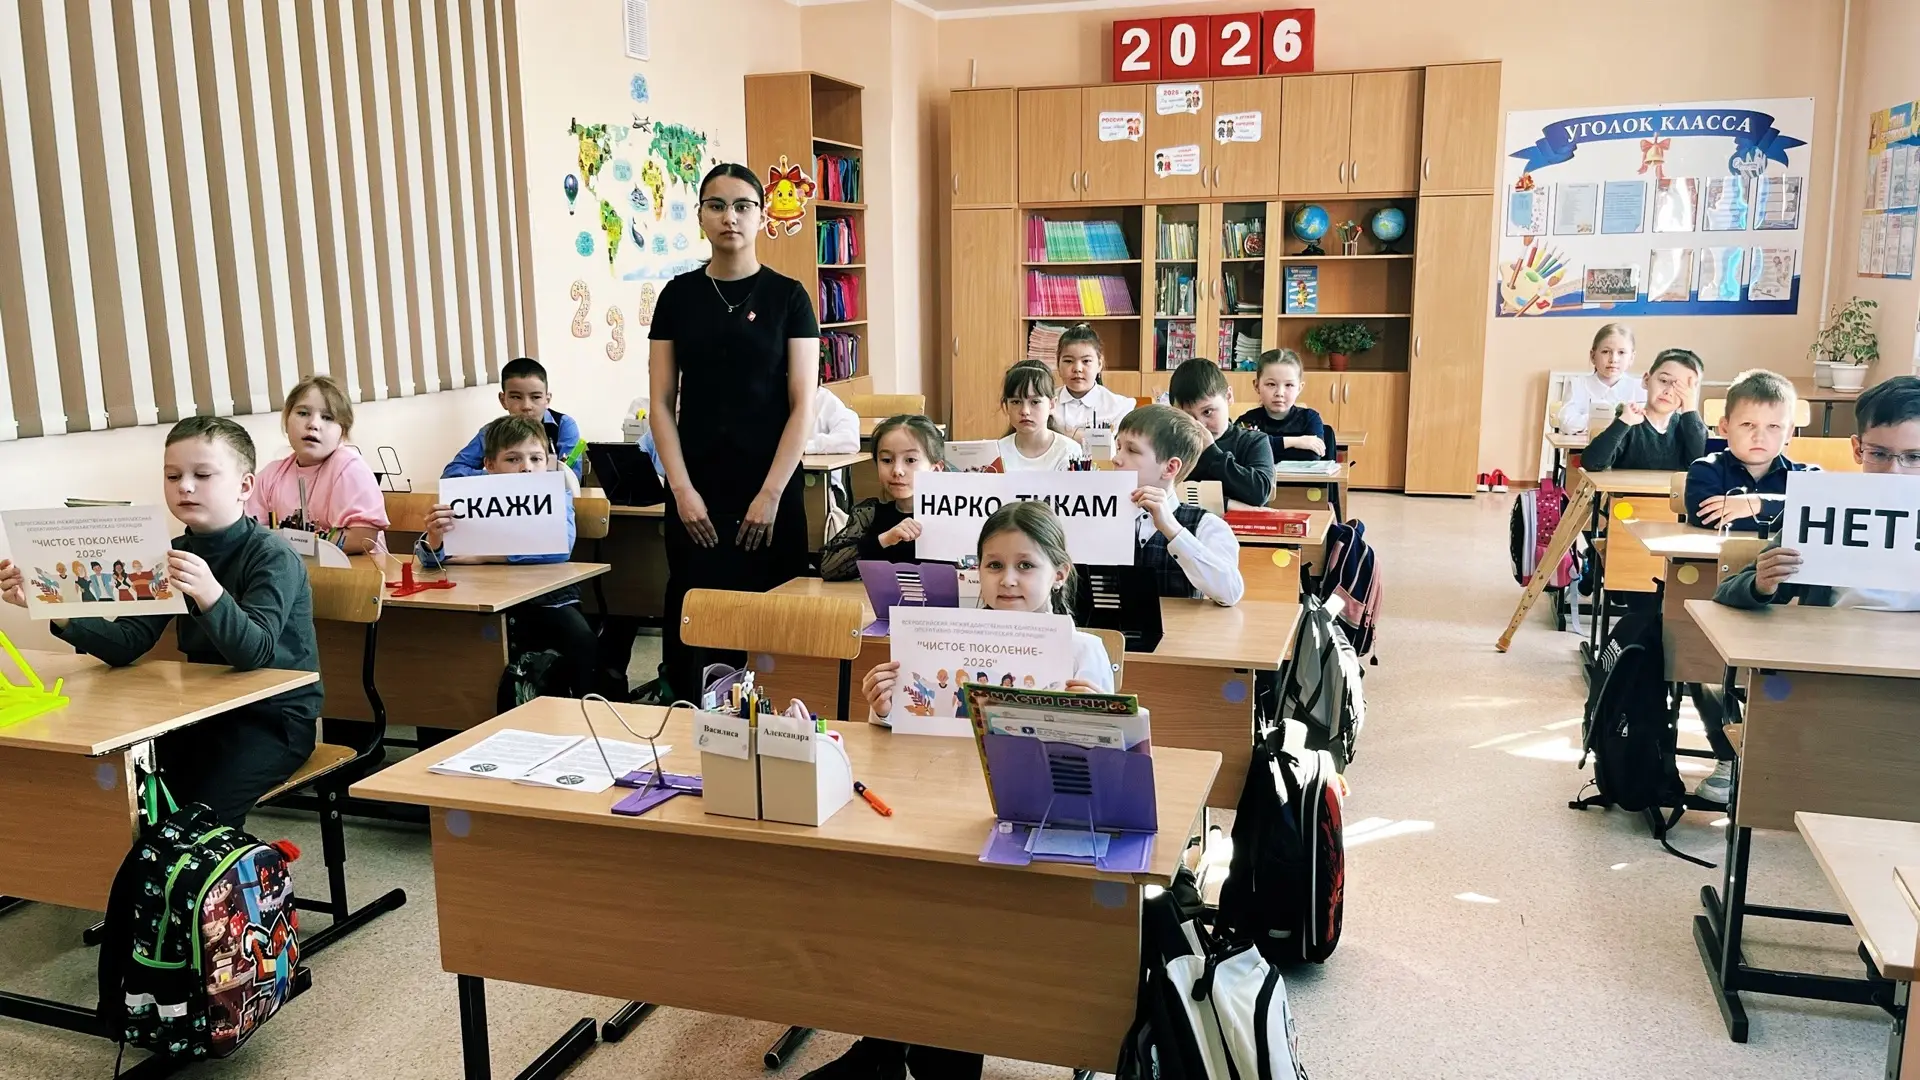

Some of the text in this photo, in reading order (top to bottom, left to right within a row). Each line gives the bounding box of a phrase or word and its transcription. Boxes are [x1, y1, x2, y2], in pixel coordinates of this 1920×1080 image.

[1121, 18, 1302, 72] 2026
[1564, 115, 1751, 142] УГОЛОК КЛАССА
[449, 494, 552, 519] СКАЖИ
[921, 494, 1117, 517] НАРКО ТКАМ
[1798, 506, 1920, 551] НЕТ!
[32, 535, 144, 547] "ЧИСТОЕ ПОКОЛЕНИЕ-
[75, 549, 106, 558] 2026"
[917, 640, 1043, 656] "ЧИСТОЕ ПОКОЛЕНИЕ-
[963, 657, 998, 668] 2026"
[991, 691, 1107, 710] ЧАСТИ РЕЧИ
[704, 724, 739, 738] Василиса
[763, 728, 809, 742] Александра
